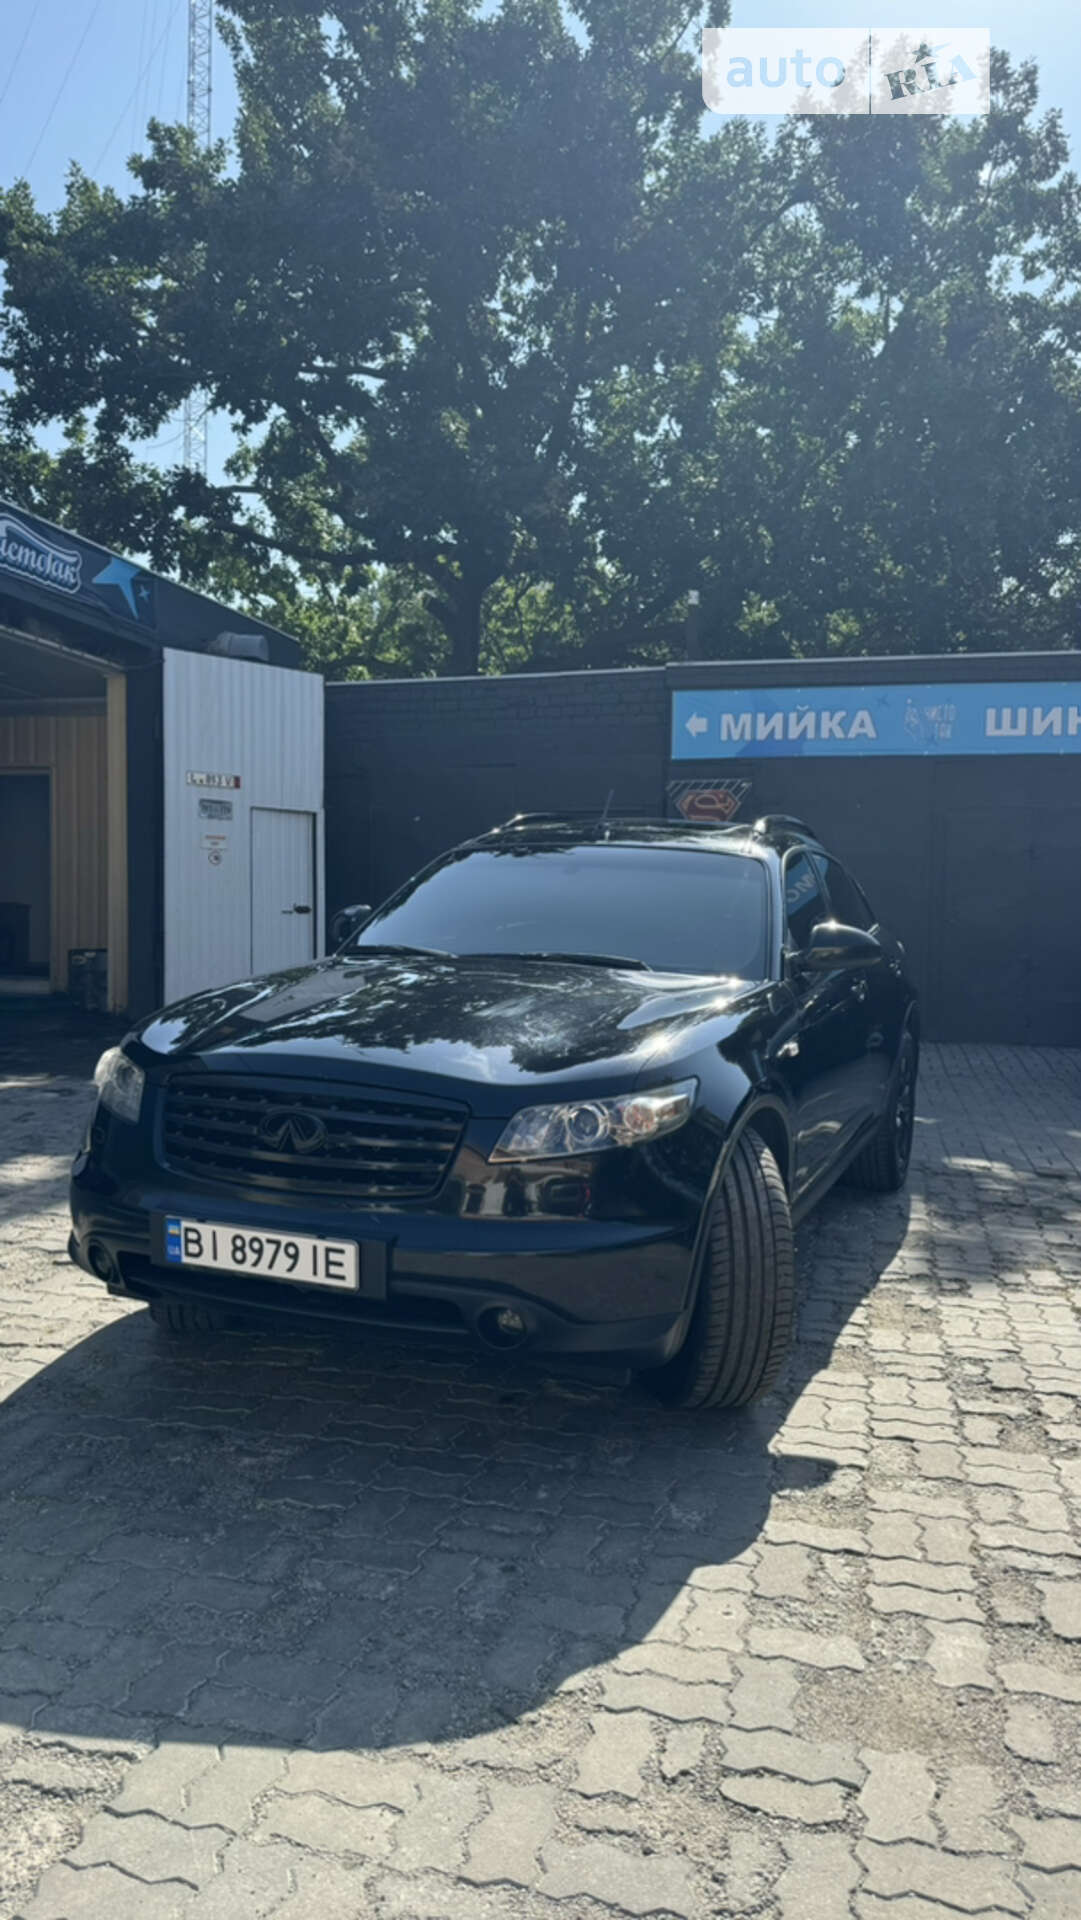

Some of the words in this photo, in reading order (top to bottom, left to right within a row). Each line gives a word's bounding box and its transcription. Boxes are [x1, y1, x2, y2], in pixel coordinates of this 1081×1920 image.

[719, 704, 877, 741] МИЙКА
[184, 1226, 218, 1261] BI
[230, 1233, 300, 1273] 8979
[312, 1244, 347, 1281] IE
